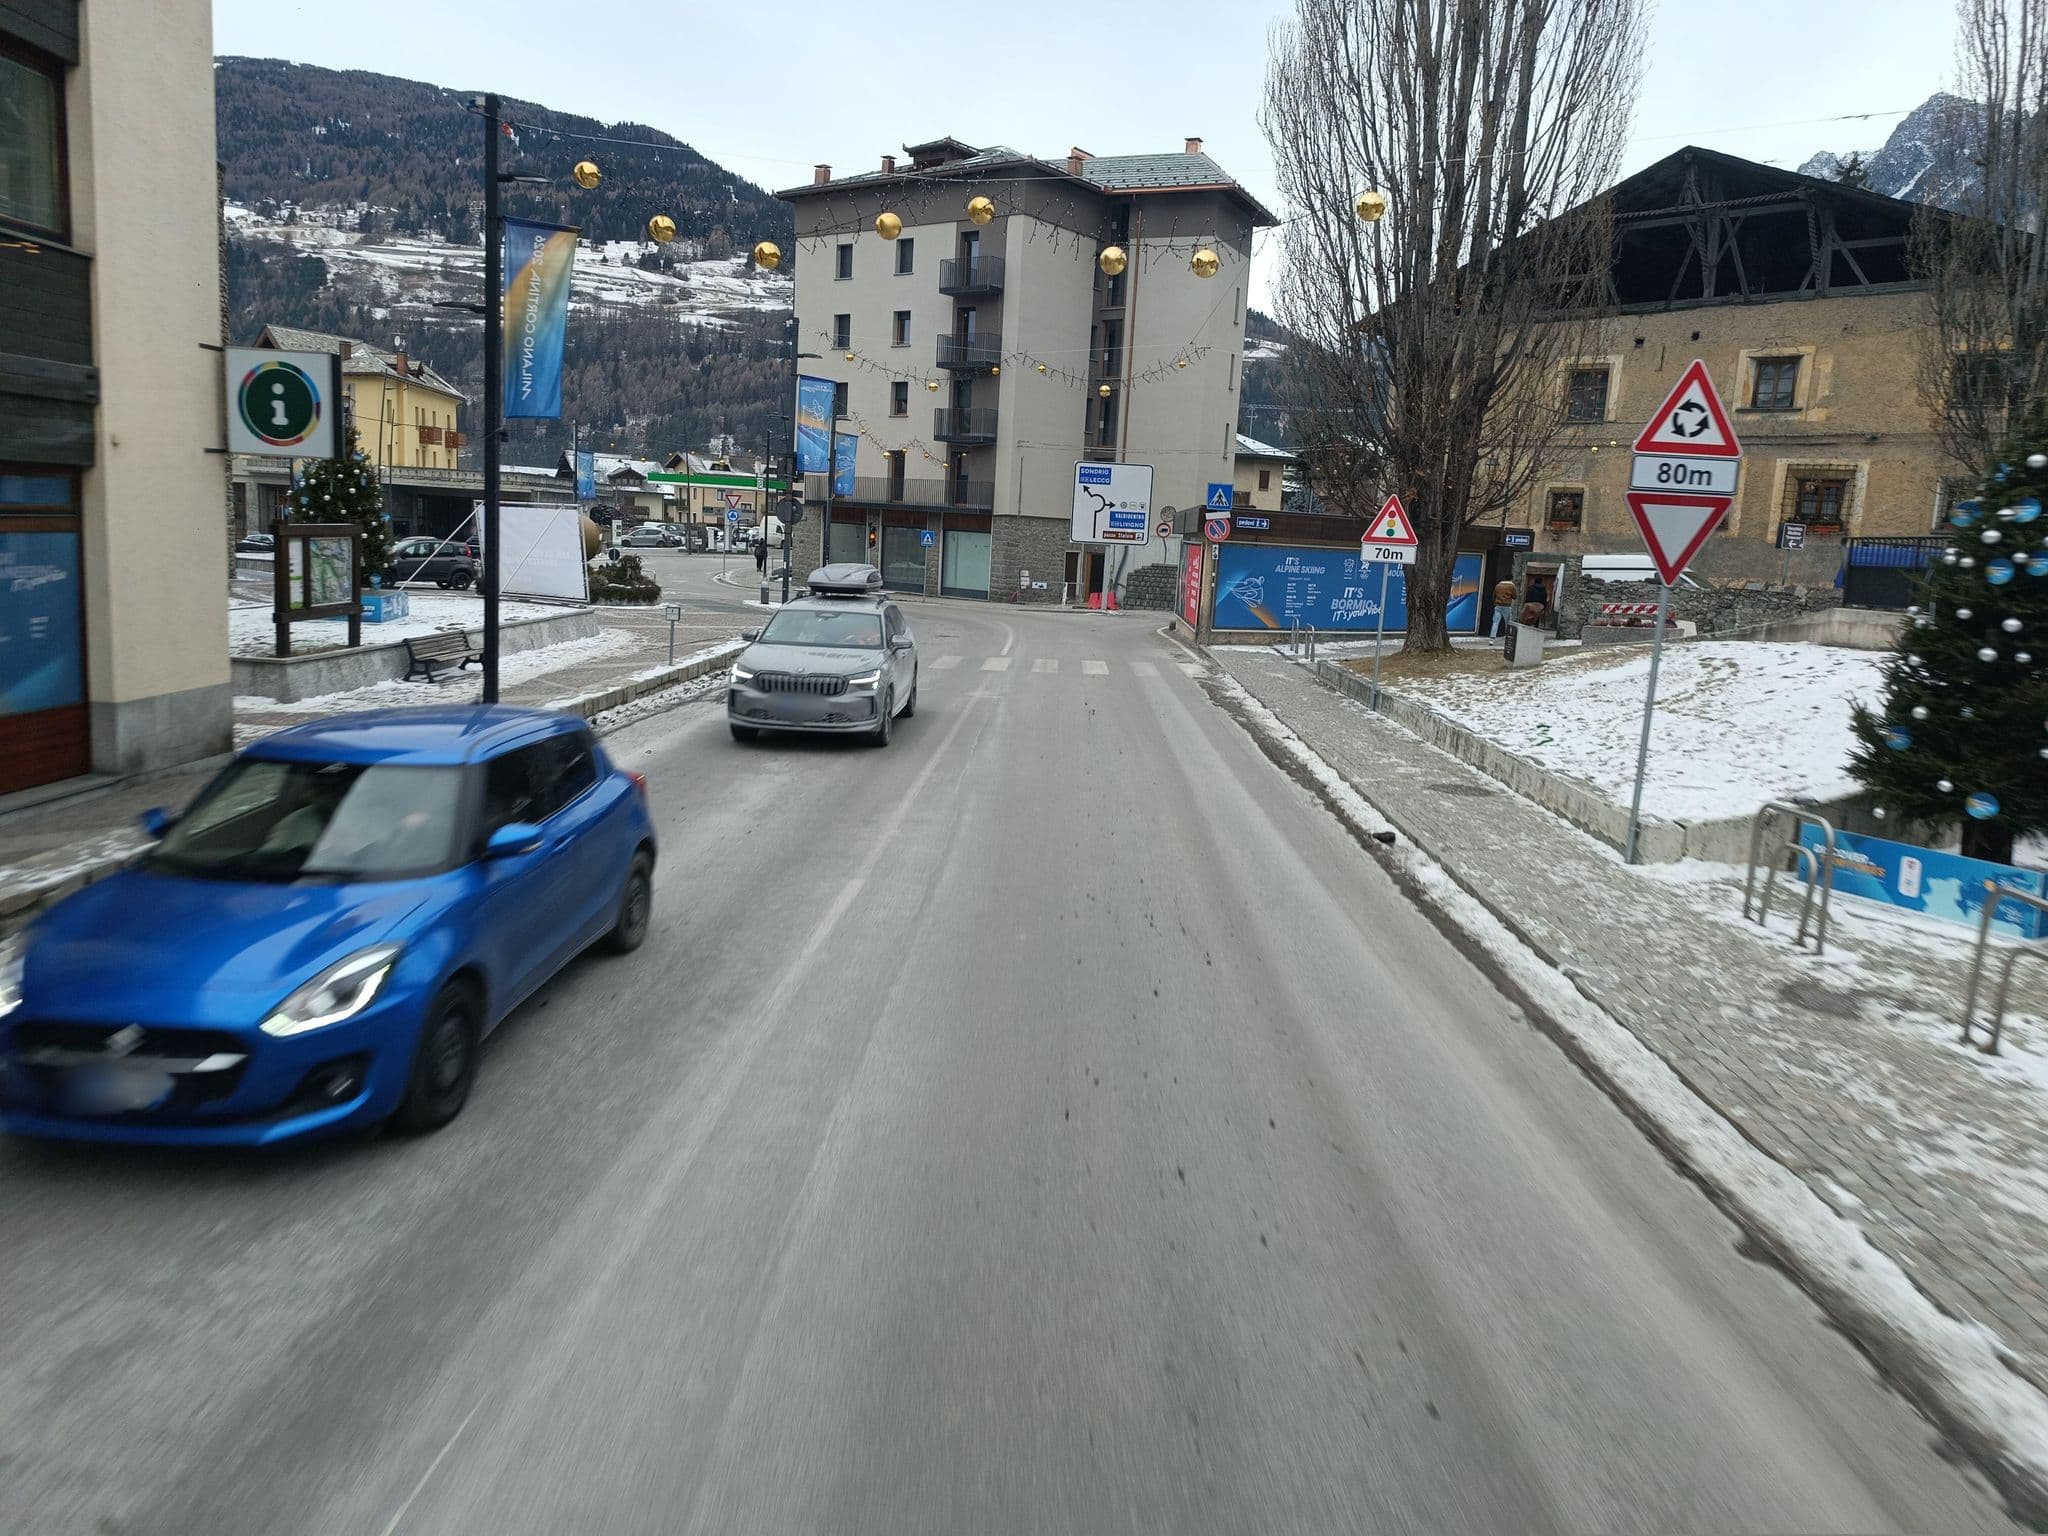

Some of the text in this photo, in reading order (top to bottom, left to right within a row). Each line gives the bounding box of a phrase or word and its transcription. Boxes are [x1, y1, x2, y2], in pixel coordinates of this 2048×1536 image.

[1657, 463, 1712, 486] 80m
[1375, 547, 1403, 560] 70m
[1285, 557, 1300, 565] IT'S
[1275, 565, 1326, 575] ALPINE SKIING
[1343, 587, 1364, 598] IT'S
[1330, 599, 1374, 610] BORMIO
